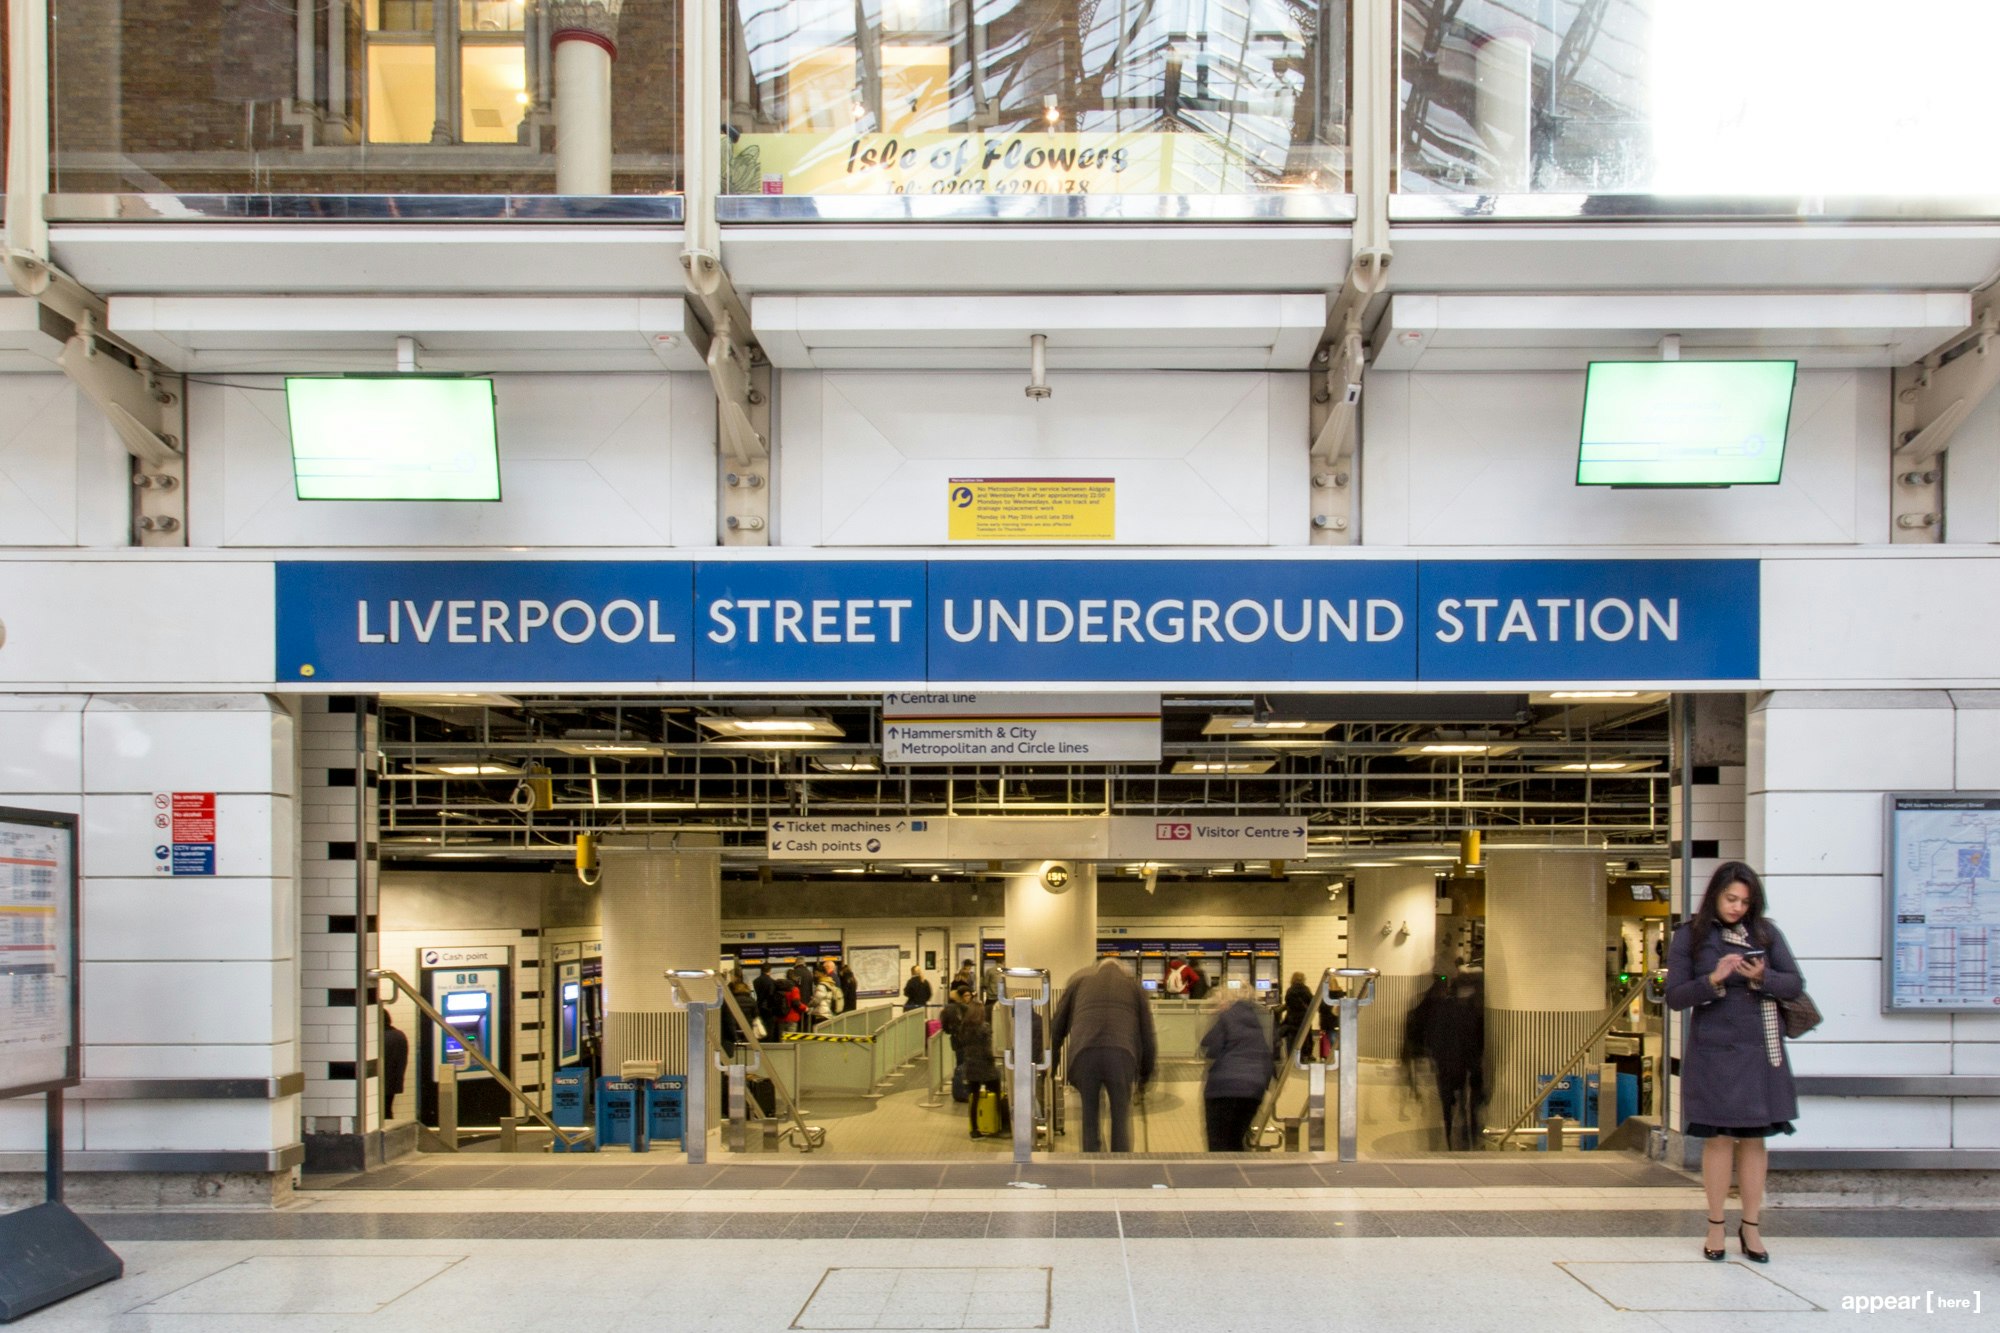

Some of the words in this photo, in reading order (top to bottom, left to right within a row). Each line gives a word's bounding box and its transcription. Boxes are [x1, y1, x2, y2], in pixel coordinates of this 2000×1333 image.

[847, 139, 917, 173] Isle
[930, 139, 968, 176] of
[982, 139, 1128, 173] Flowers
[358, 600, 676, 643] LIVERPOOL
[707, 599, 912, 643] STREET
[943, 598, 1404, 643] UNDERGROUND
[1435, 598, 1680, 643] STATION
[900, 693, 949, 704] Central
[953, 693, 976, 703] line
[901, 727, 993, 739] Hammersmith
[996, 727, 1006, 738] &
[1010, 727, 1037, 742] City
[901, 743, 987, 756] Metropolitan
[990, 743, 1014, 753] and
[1017, 742, 1056, 753] Circle
[1059, 742, 1089, 753] lines
[787, 821, 826, 832] Ticket
[831, 821, 891, 832] machines
[1197, 826, 1240, 837] Visitor
[1244, 827, 1289, 837] Centre
[787, 840, 817, 851] Cash
[822, 840, 862, 853] points
[466, 952, 488, 962] point
